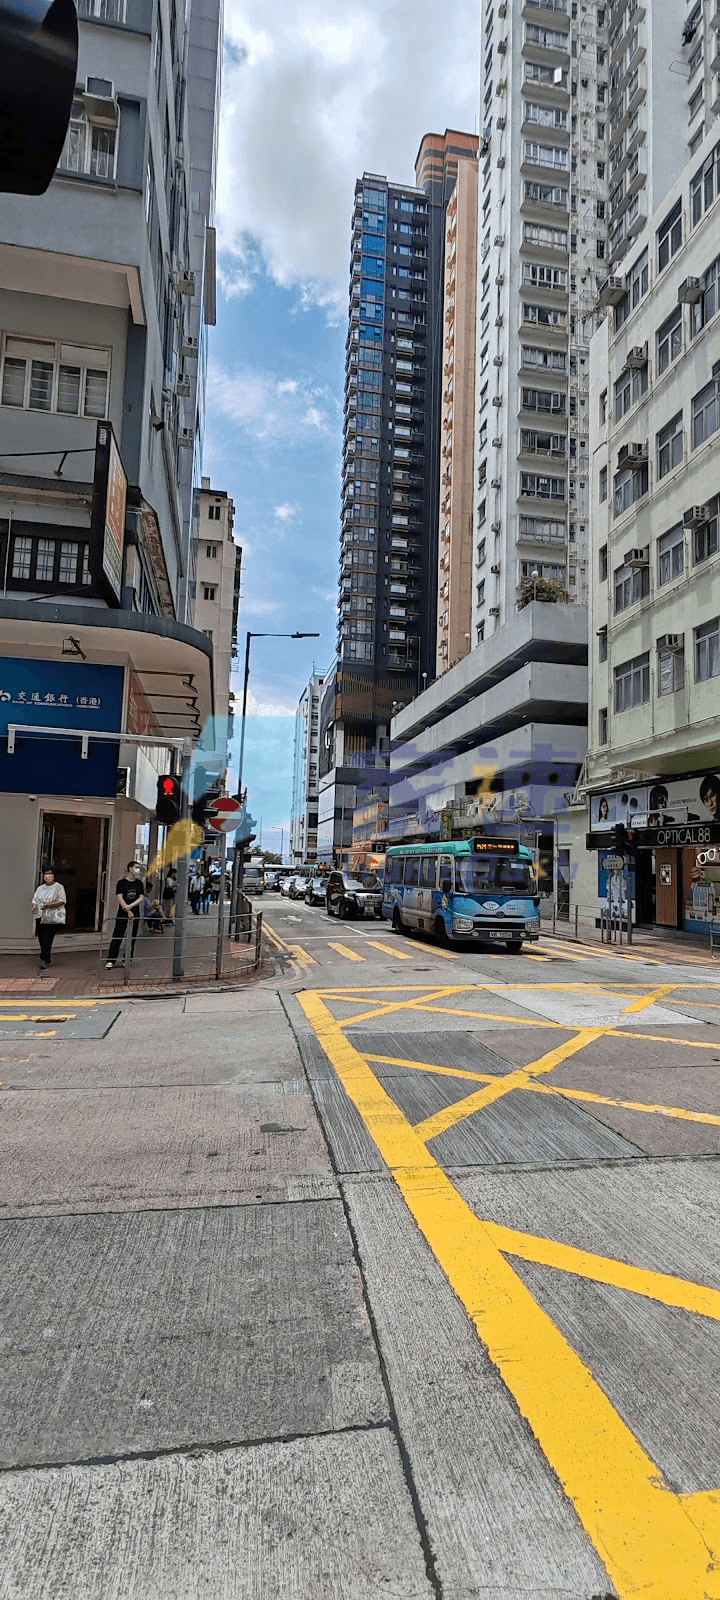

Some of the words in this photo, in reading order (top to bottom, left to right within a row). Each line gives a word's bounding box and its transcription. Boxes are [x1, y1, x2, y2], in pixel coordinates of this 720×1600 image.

[17, 691, 70, 704] 交通銀行
[76, 696, 101, 706] (香港)
[375, 844, 384, 852] P
